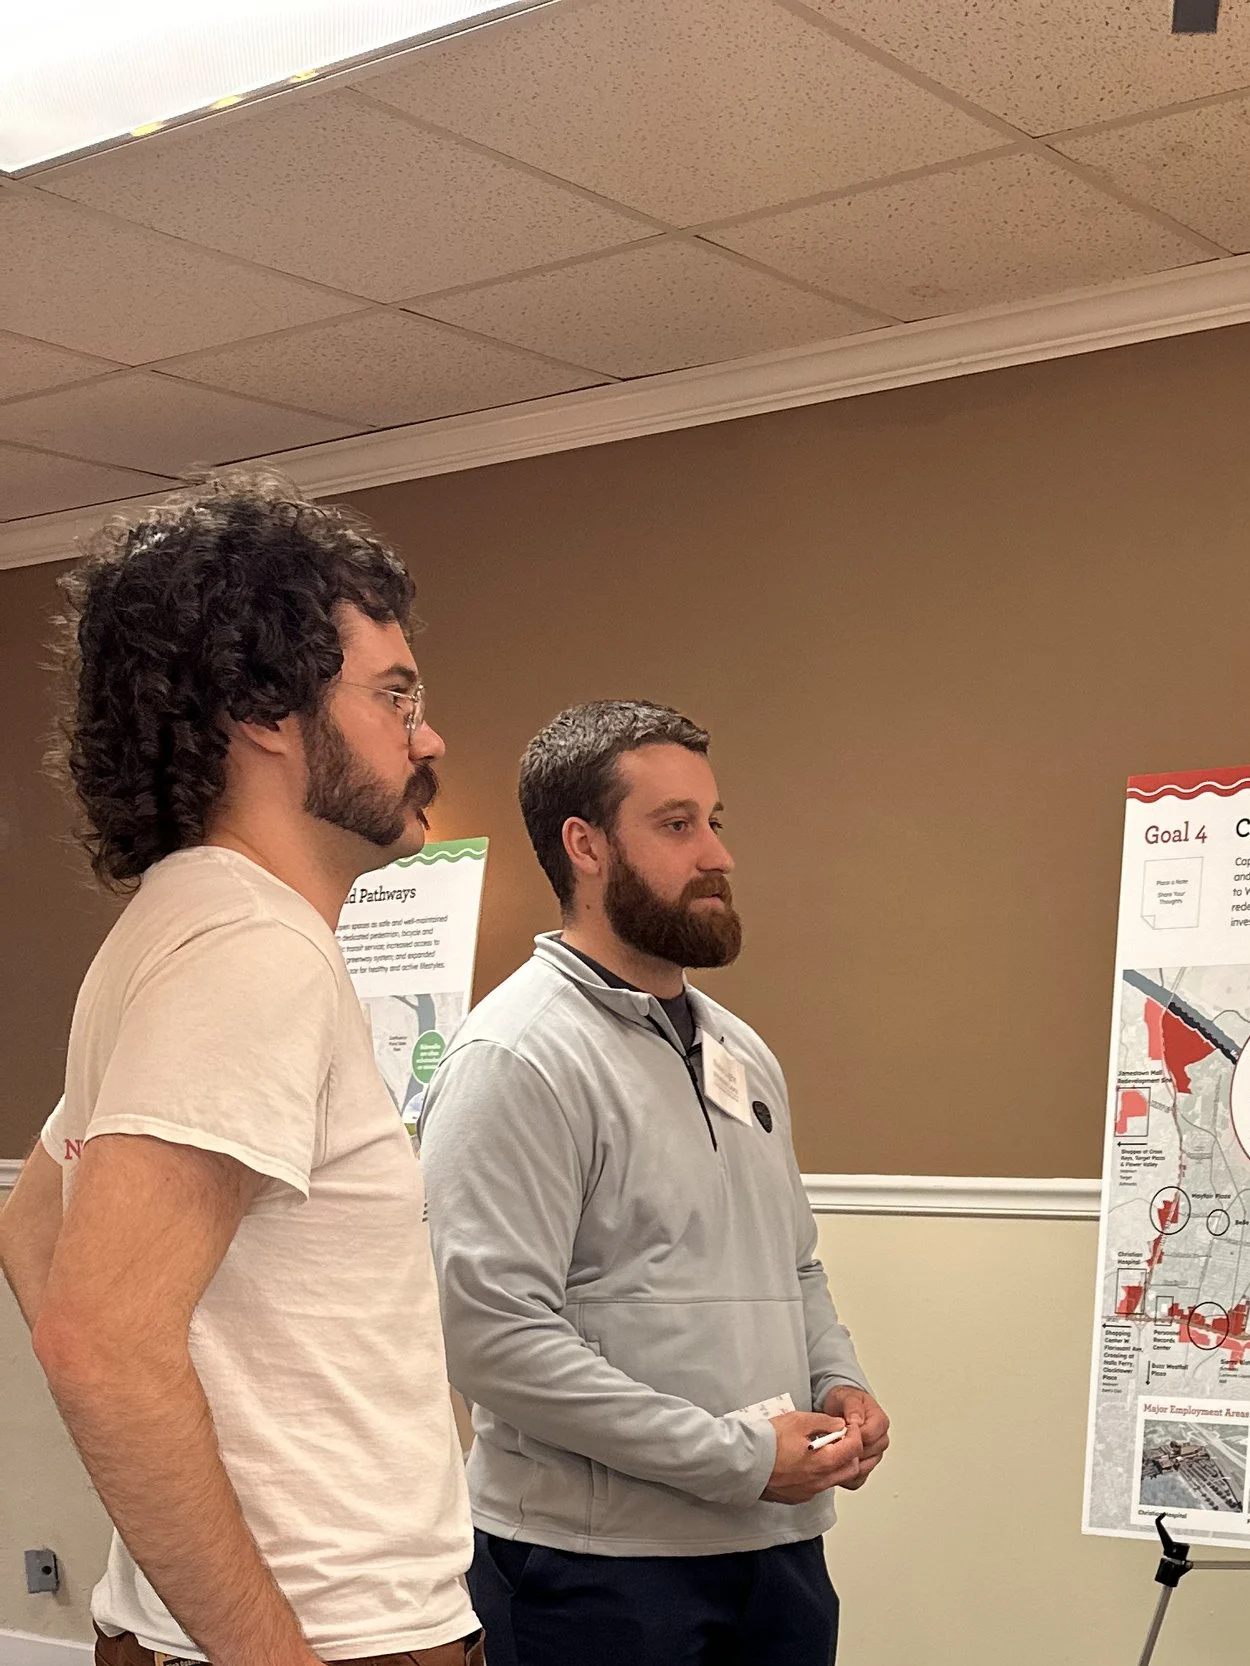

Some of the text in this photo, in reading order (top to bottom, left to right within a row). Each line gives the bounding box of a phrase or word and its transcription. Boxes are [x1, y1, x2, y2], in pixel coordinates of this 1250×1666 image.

[1144, 825, 1207, 844] Goal 4
[359, 885, 416, 903] Pathways
[1232, 888, 1242, 896] to
[1143, 1403, 1249, 1418] Major Employment Areas
